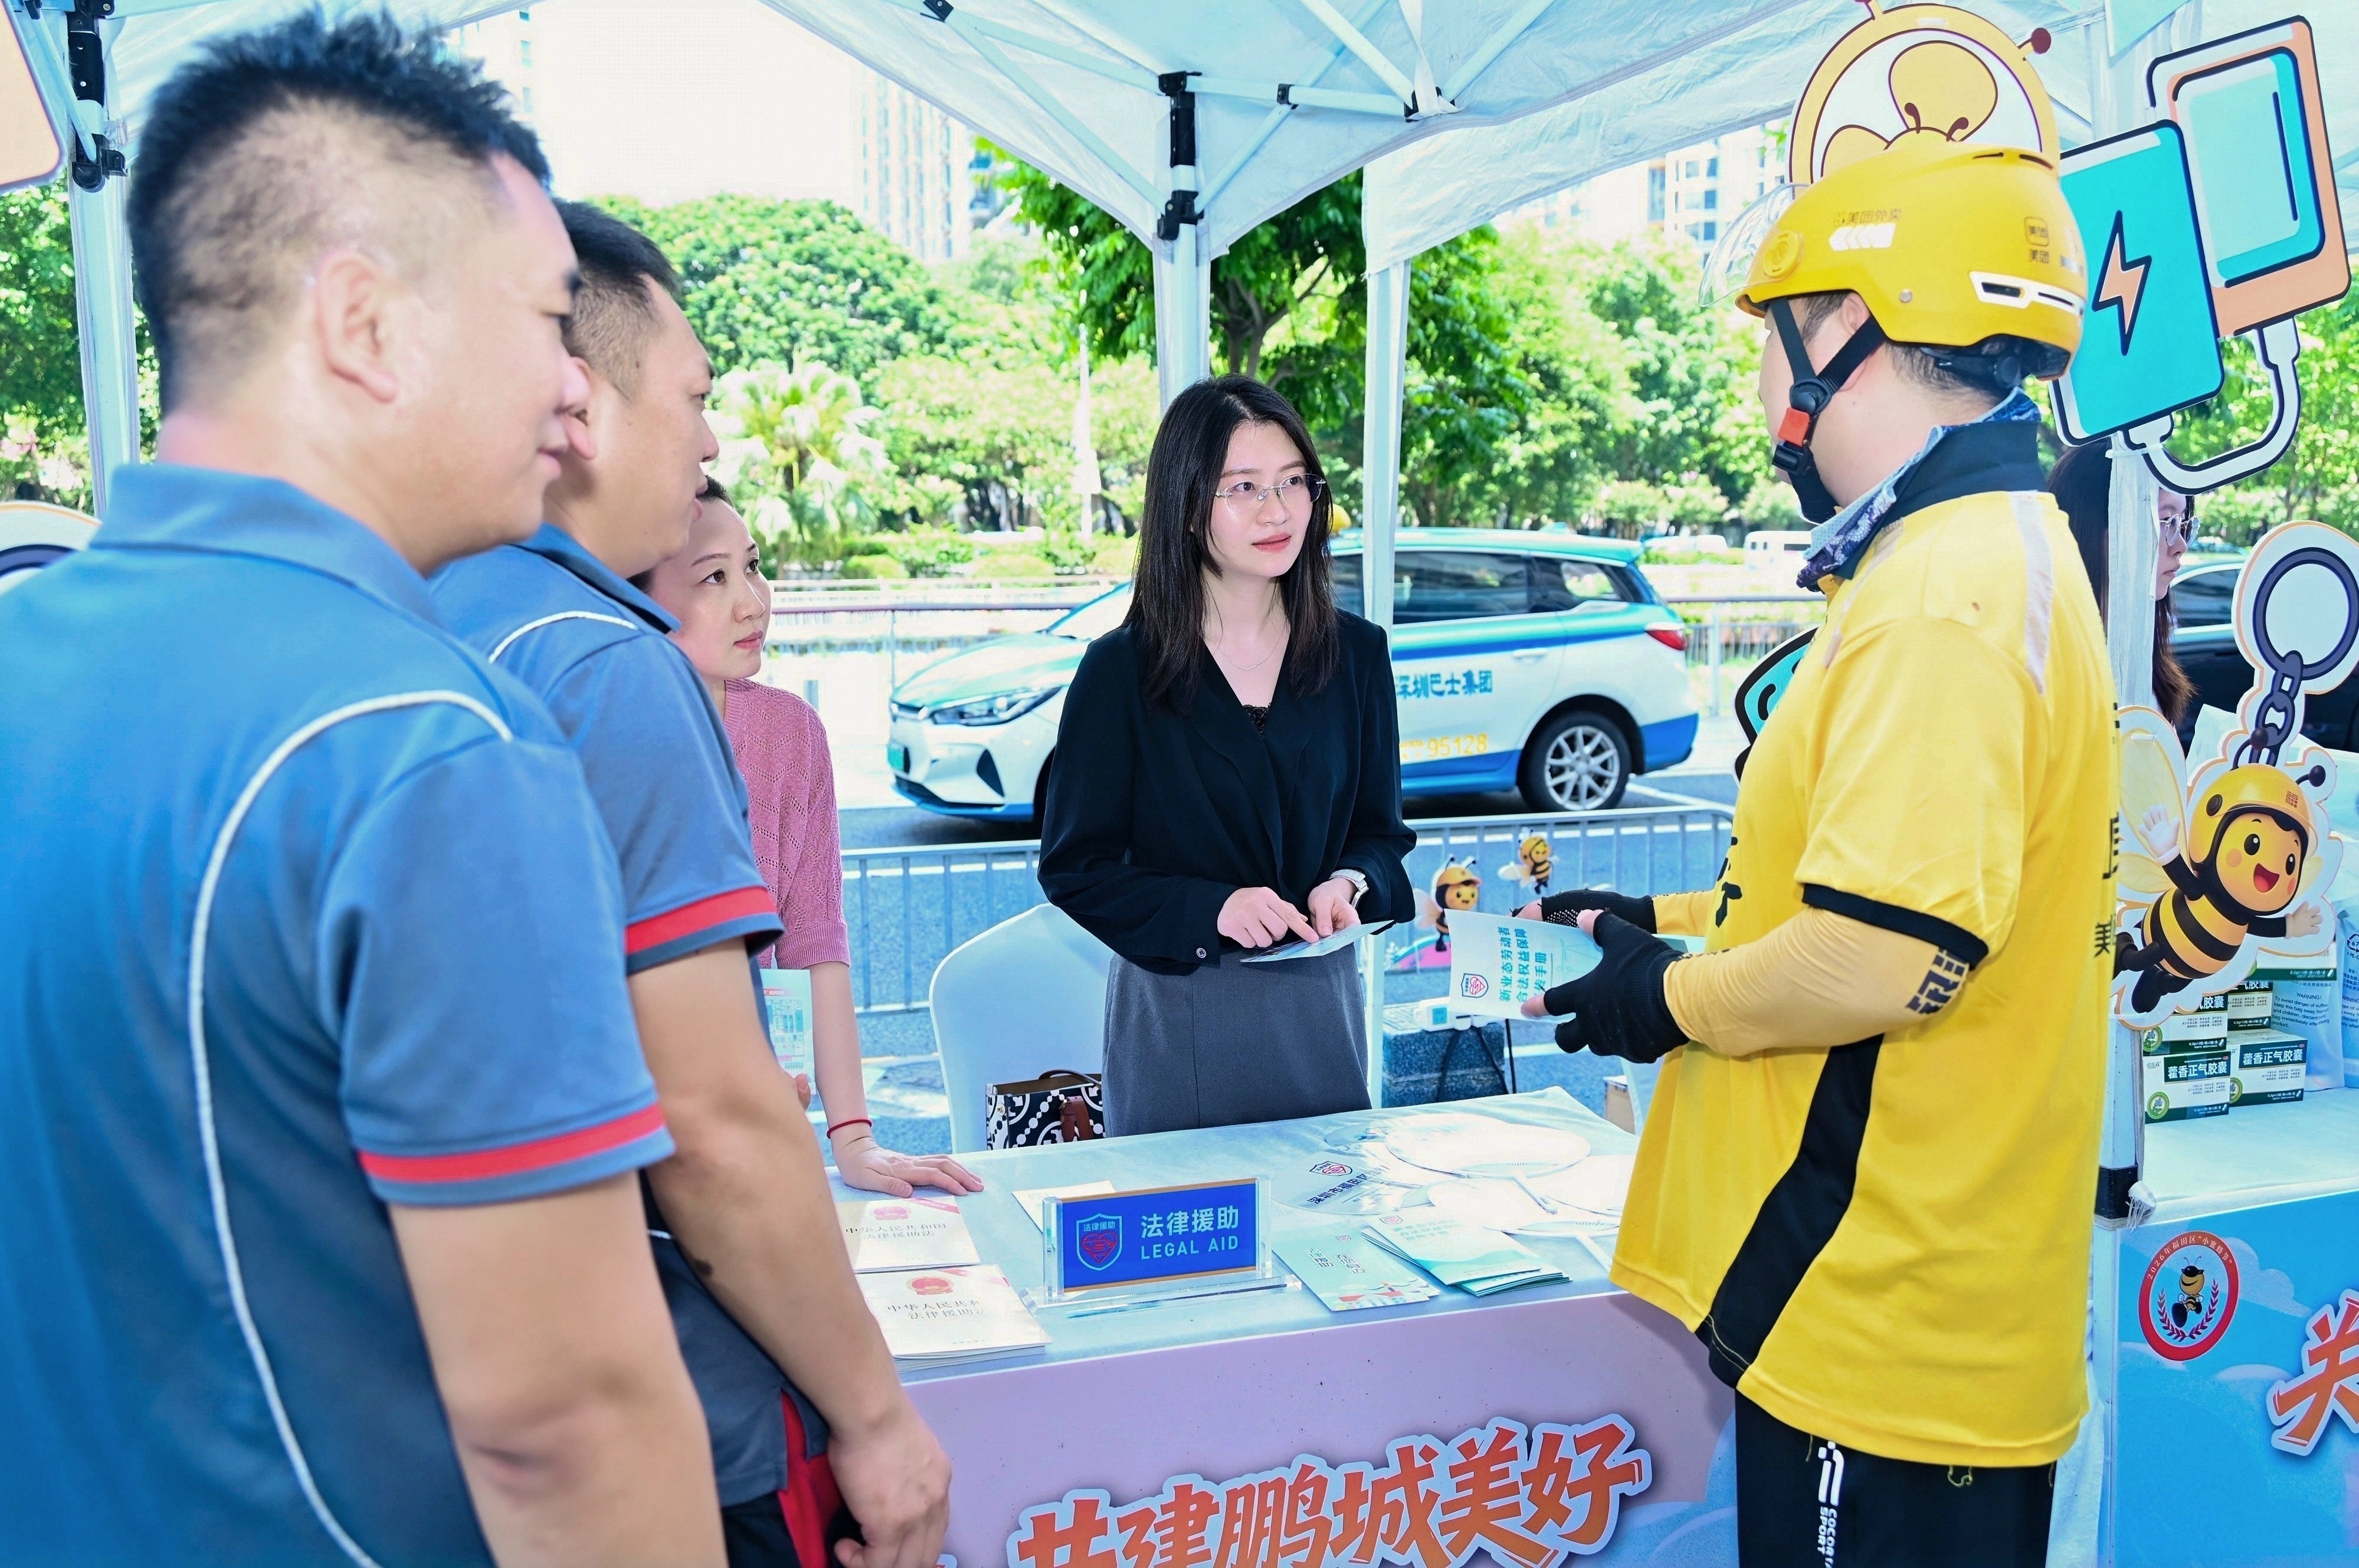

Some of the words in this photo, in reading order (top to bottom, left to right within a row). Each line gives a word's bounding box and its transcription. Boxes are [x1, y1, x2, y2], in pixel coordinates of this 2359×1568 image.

[1396, 670, 1492, 700] 深圳巴士集团
[1427, 733, 1488, 759] 95128
[1498, 927, 1513, 1002] 新业态劳动者
[1514, 928, 1530, 1003] 合法权益保障
[1534, 952, 1547, 993] 传手册
[2231, 980, 2270, 990] 气胶囊
[2281, 1016, 2308, 1026] immediately
[2242, 1048, 2304, 1066] 藿香正气胶囊
[2168, 1061, 2227, 1080] 藿香正气胶囊
[1083, 1221, 1116, 1232] 法律援助
[1140, 1205, 1239, 1239] 法律援助
[1141, 1240, 1200, 1260] LEGAL
[1208, 1235, 1239, 1252] AID
[1817, 1506, 1829, 1556] SPORT
